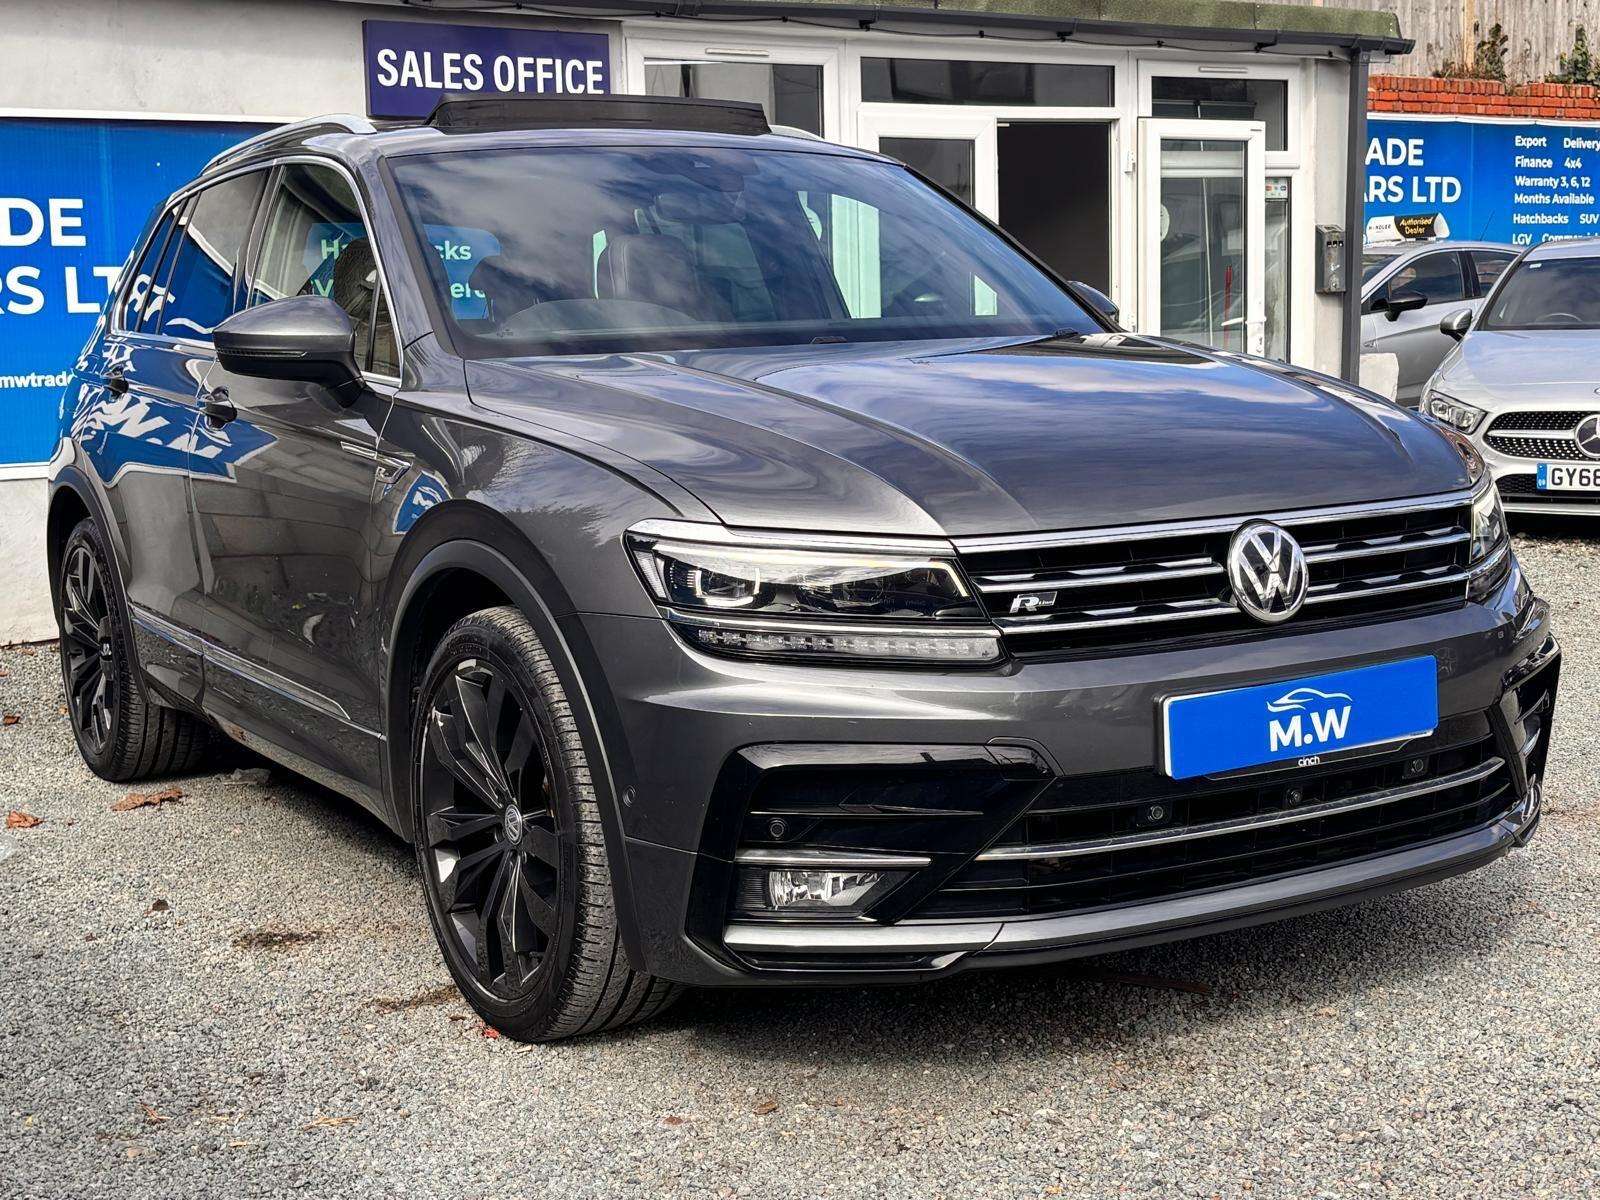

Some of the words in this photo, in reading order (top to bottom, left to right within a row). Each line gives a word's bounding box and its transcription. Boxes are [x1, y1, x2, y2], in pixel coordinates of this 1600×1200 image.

[377, 48, 484, 91] SALES
[493, 55, 604, 95] OFFICE
[1515, 135, 1547, 149] Export
[1563, 137, 1600, 152] Delivery
[1515, 156, 1553, 168] Finance
[1564, 157, 1583, 169] 4x4
[1515, 175, 1559, 189] Warranty
[1560, 176, 1569, 189] 3,
[1570, 176, 1580, 189] 6,
[1581, 176, 1591, 188] 12
[1364, 175, 1404, 203] RS
[1412, 175, 1462, 203] LTD
[1514, 193, 1551, 204] Months
[1552, 193, 1595, 204] Available
[1400, 217, 1434, 227] Authorised
[1513, 213, 1569, 224] Hatchbacks
[1580, 213, 1599, 224] SUV
[1404, 226, 1426, 235] Dealer
[1512, 233, 1532, 245] LGV
[1298, 756, 1321, 767] cinch
